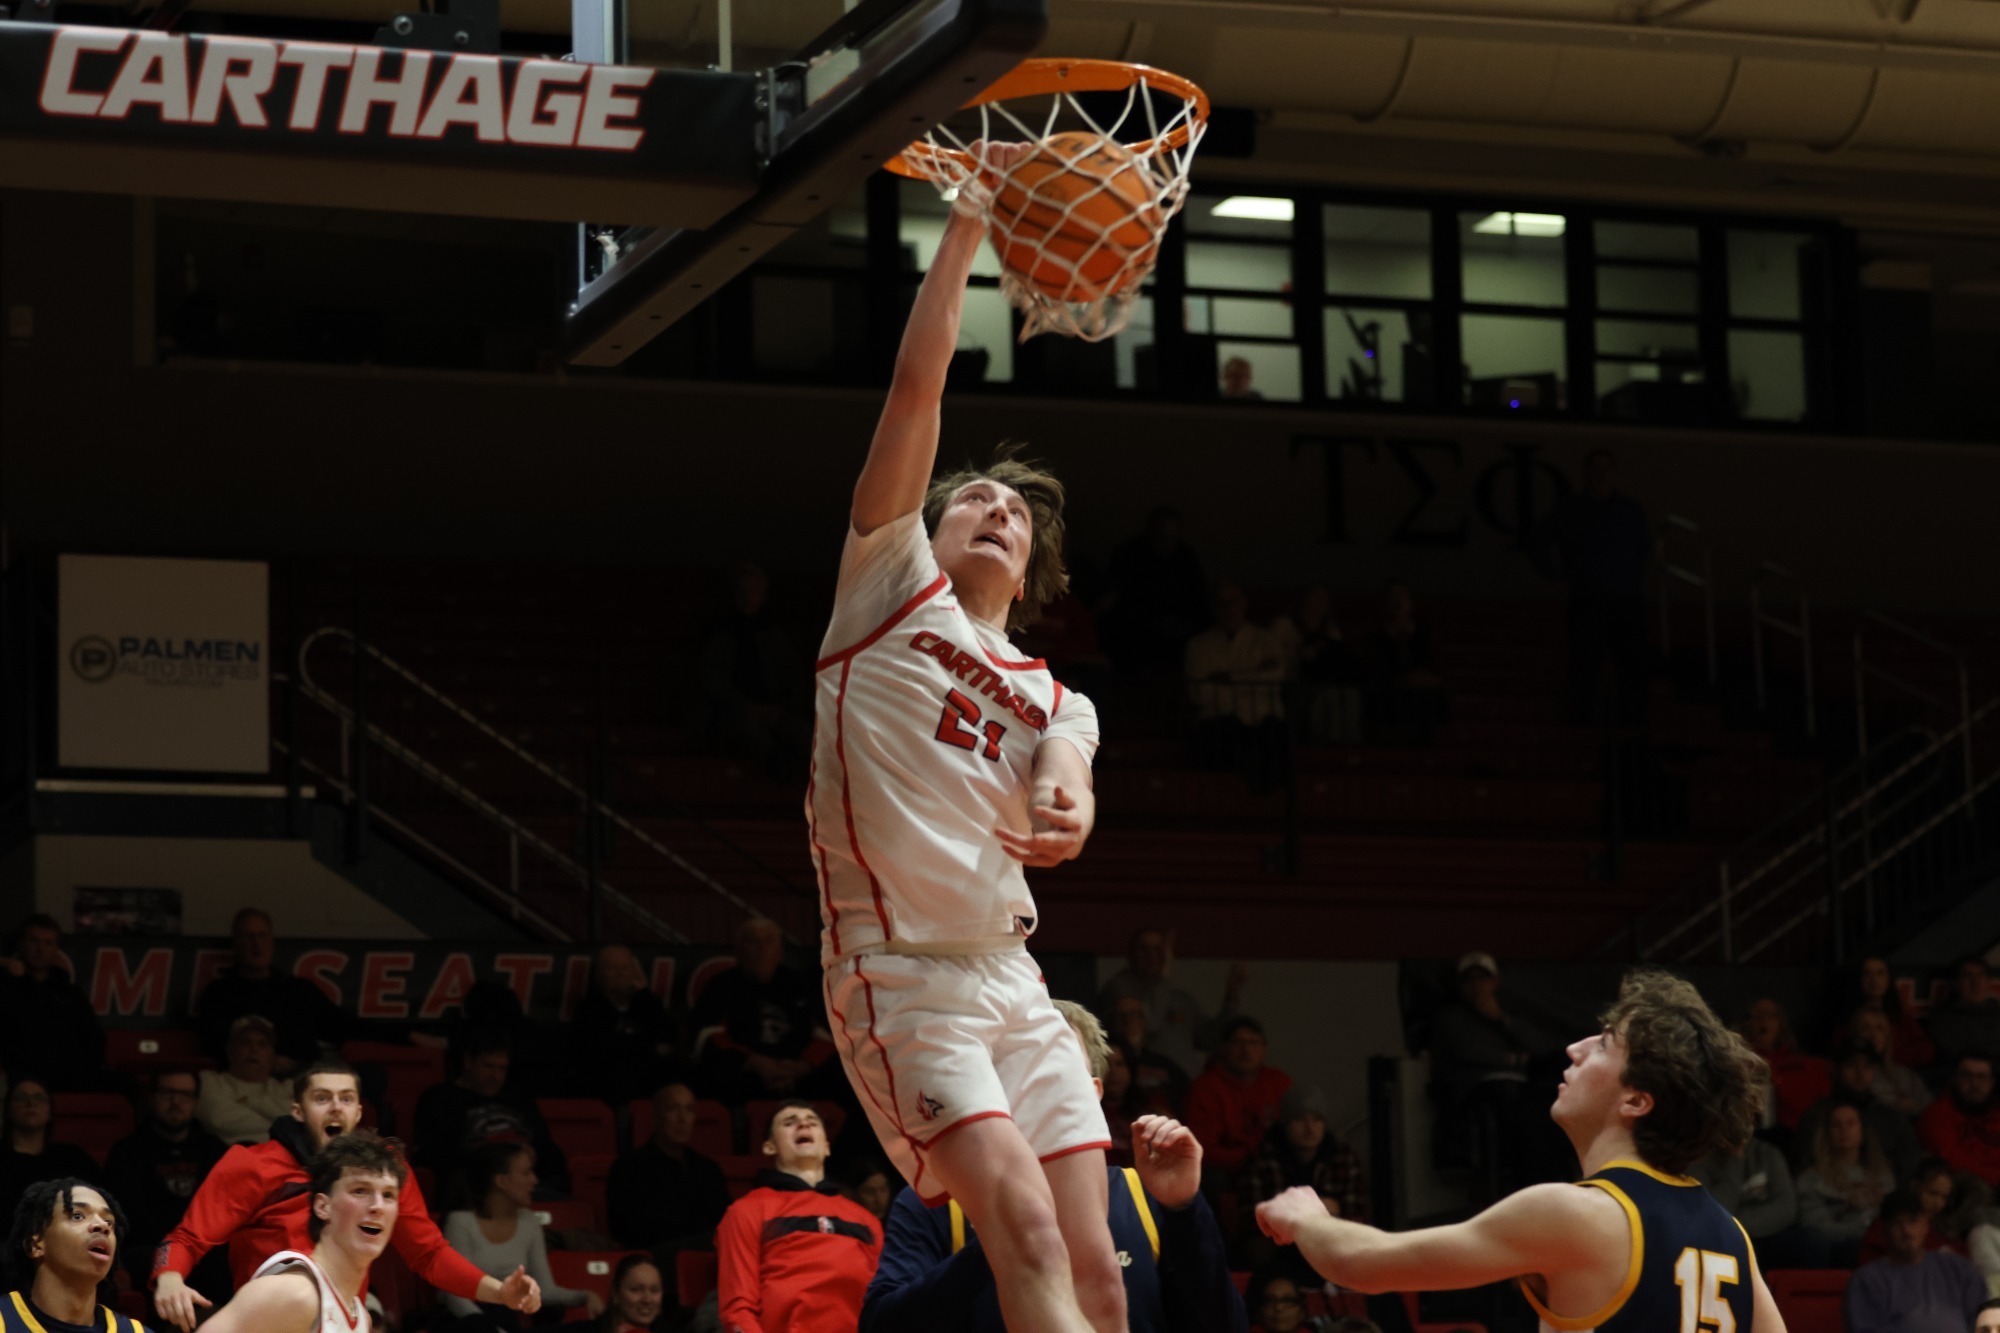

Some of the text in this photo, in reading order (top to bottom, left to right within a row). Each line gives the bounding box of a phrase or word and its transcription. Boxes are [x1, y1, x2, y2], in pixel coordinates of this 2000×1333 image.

[38, 27, 657, 151] CARTHAGE
[119, 637, 260, 662] PALMEN
[909, 630, 1048, 733] CARTHAG
[935, 687, 1007, 762] 21
[1673, 1245, 1740, 1333] 15
